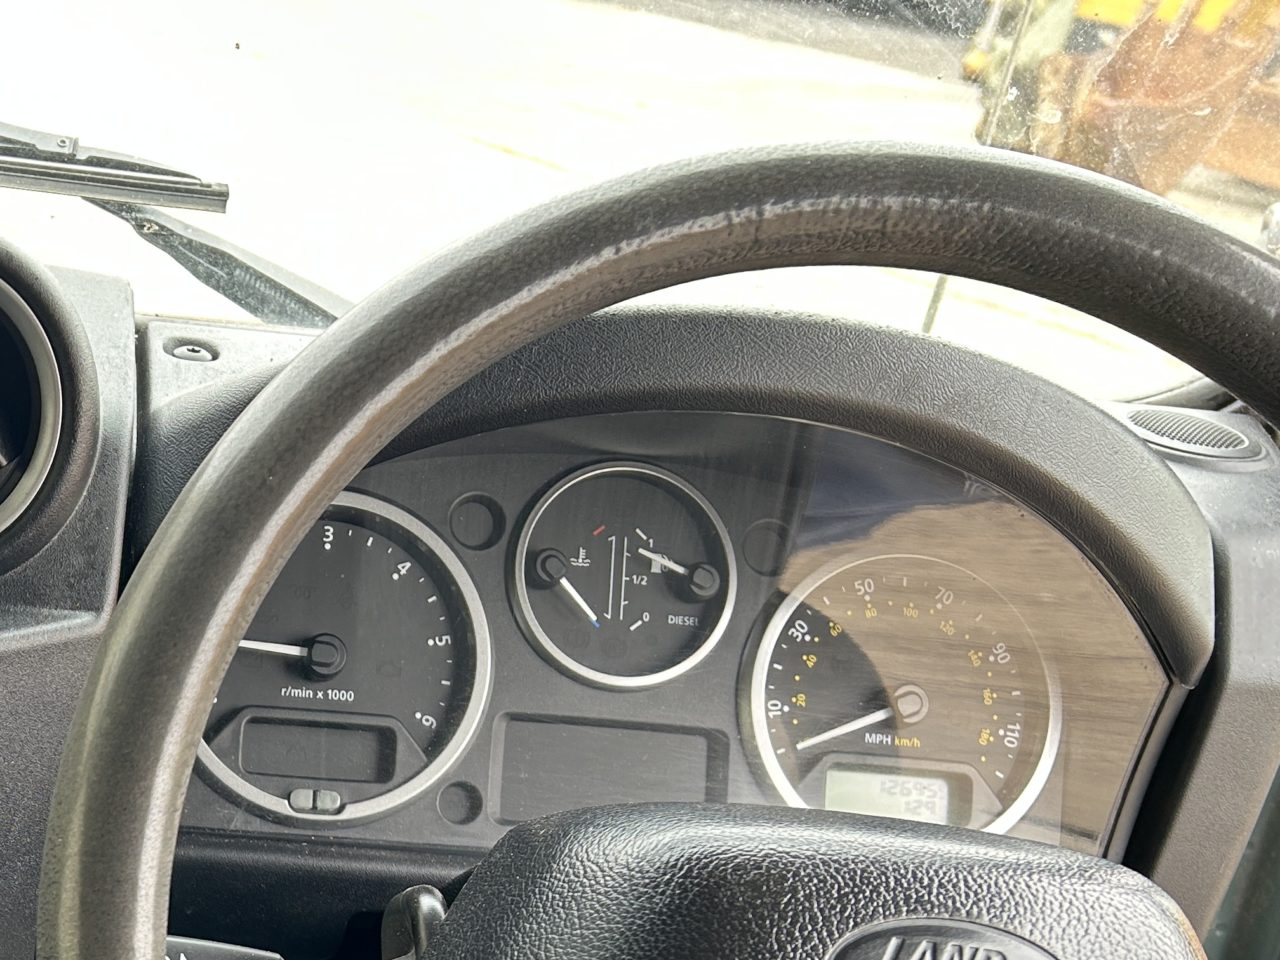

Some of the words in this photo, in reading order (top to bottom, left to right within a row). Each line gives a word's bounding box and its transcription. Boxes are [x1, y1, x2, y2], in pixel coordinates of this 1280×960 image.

[323, 526, 334, 542] 3
[648, 539, 654, 548] 1
[397, 560, 412, 576] 4
[631, 574, 648, 586] 1/2
[854, 578, 875, 596] 50
[934, 585, 954, 605] 70
[642, 612, 650, 622] 0
[903, 606, 919, 618] 100
[668, 615, 699, 626] DIESEL
[787, 619, 808, 643] 30
[830, 624, 842, 638] 60
[435, 634, 451, 646] 5
[992, 642, 1011, 664] 90
[805, 654, 817, 669] 40
[281, 686, 314, 699] r/min
[316, 691, 324, 699] x
[327, 689, 355, 701] 1000
[796, 693, 806, 708] 20
[767, 699, 782, 719] 10
[421, 714, 437, 729] 6
[864, 732, 892, 745] MPH
[894, 735, 921, 748] km/h
[1003, 722, 1021, 748] 110
